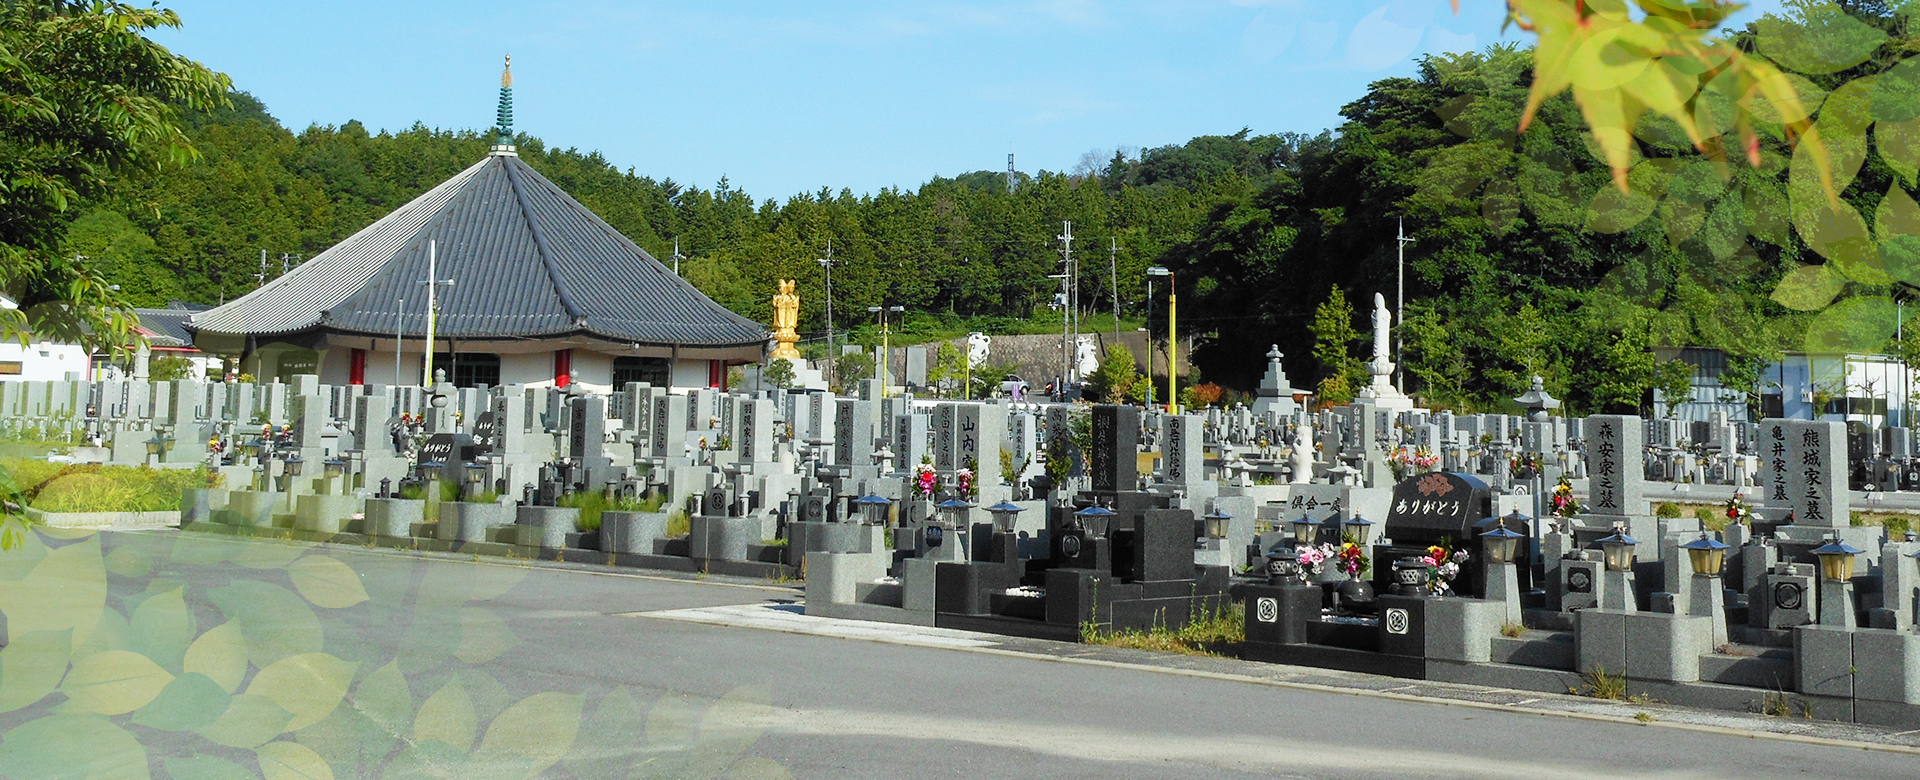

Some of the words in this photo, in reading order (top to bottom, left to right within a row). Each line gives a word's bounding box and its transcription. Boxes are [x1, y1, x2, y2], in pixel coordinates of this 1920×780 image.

[940, 405, 951, 467] 原田家之墓
[1597, 421, 1617, 509] 森安家之墓
[1771, 424, 1790, 501] 亀井家之墓
[1802, 427, 1825, 521] 熊城家之墓
[1395, 498, 1461, 518] ありがとう
